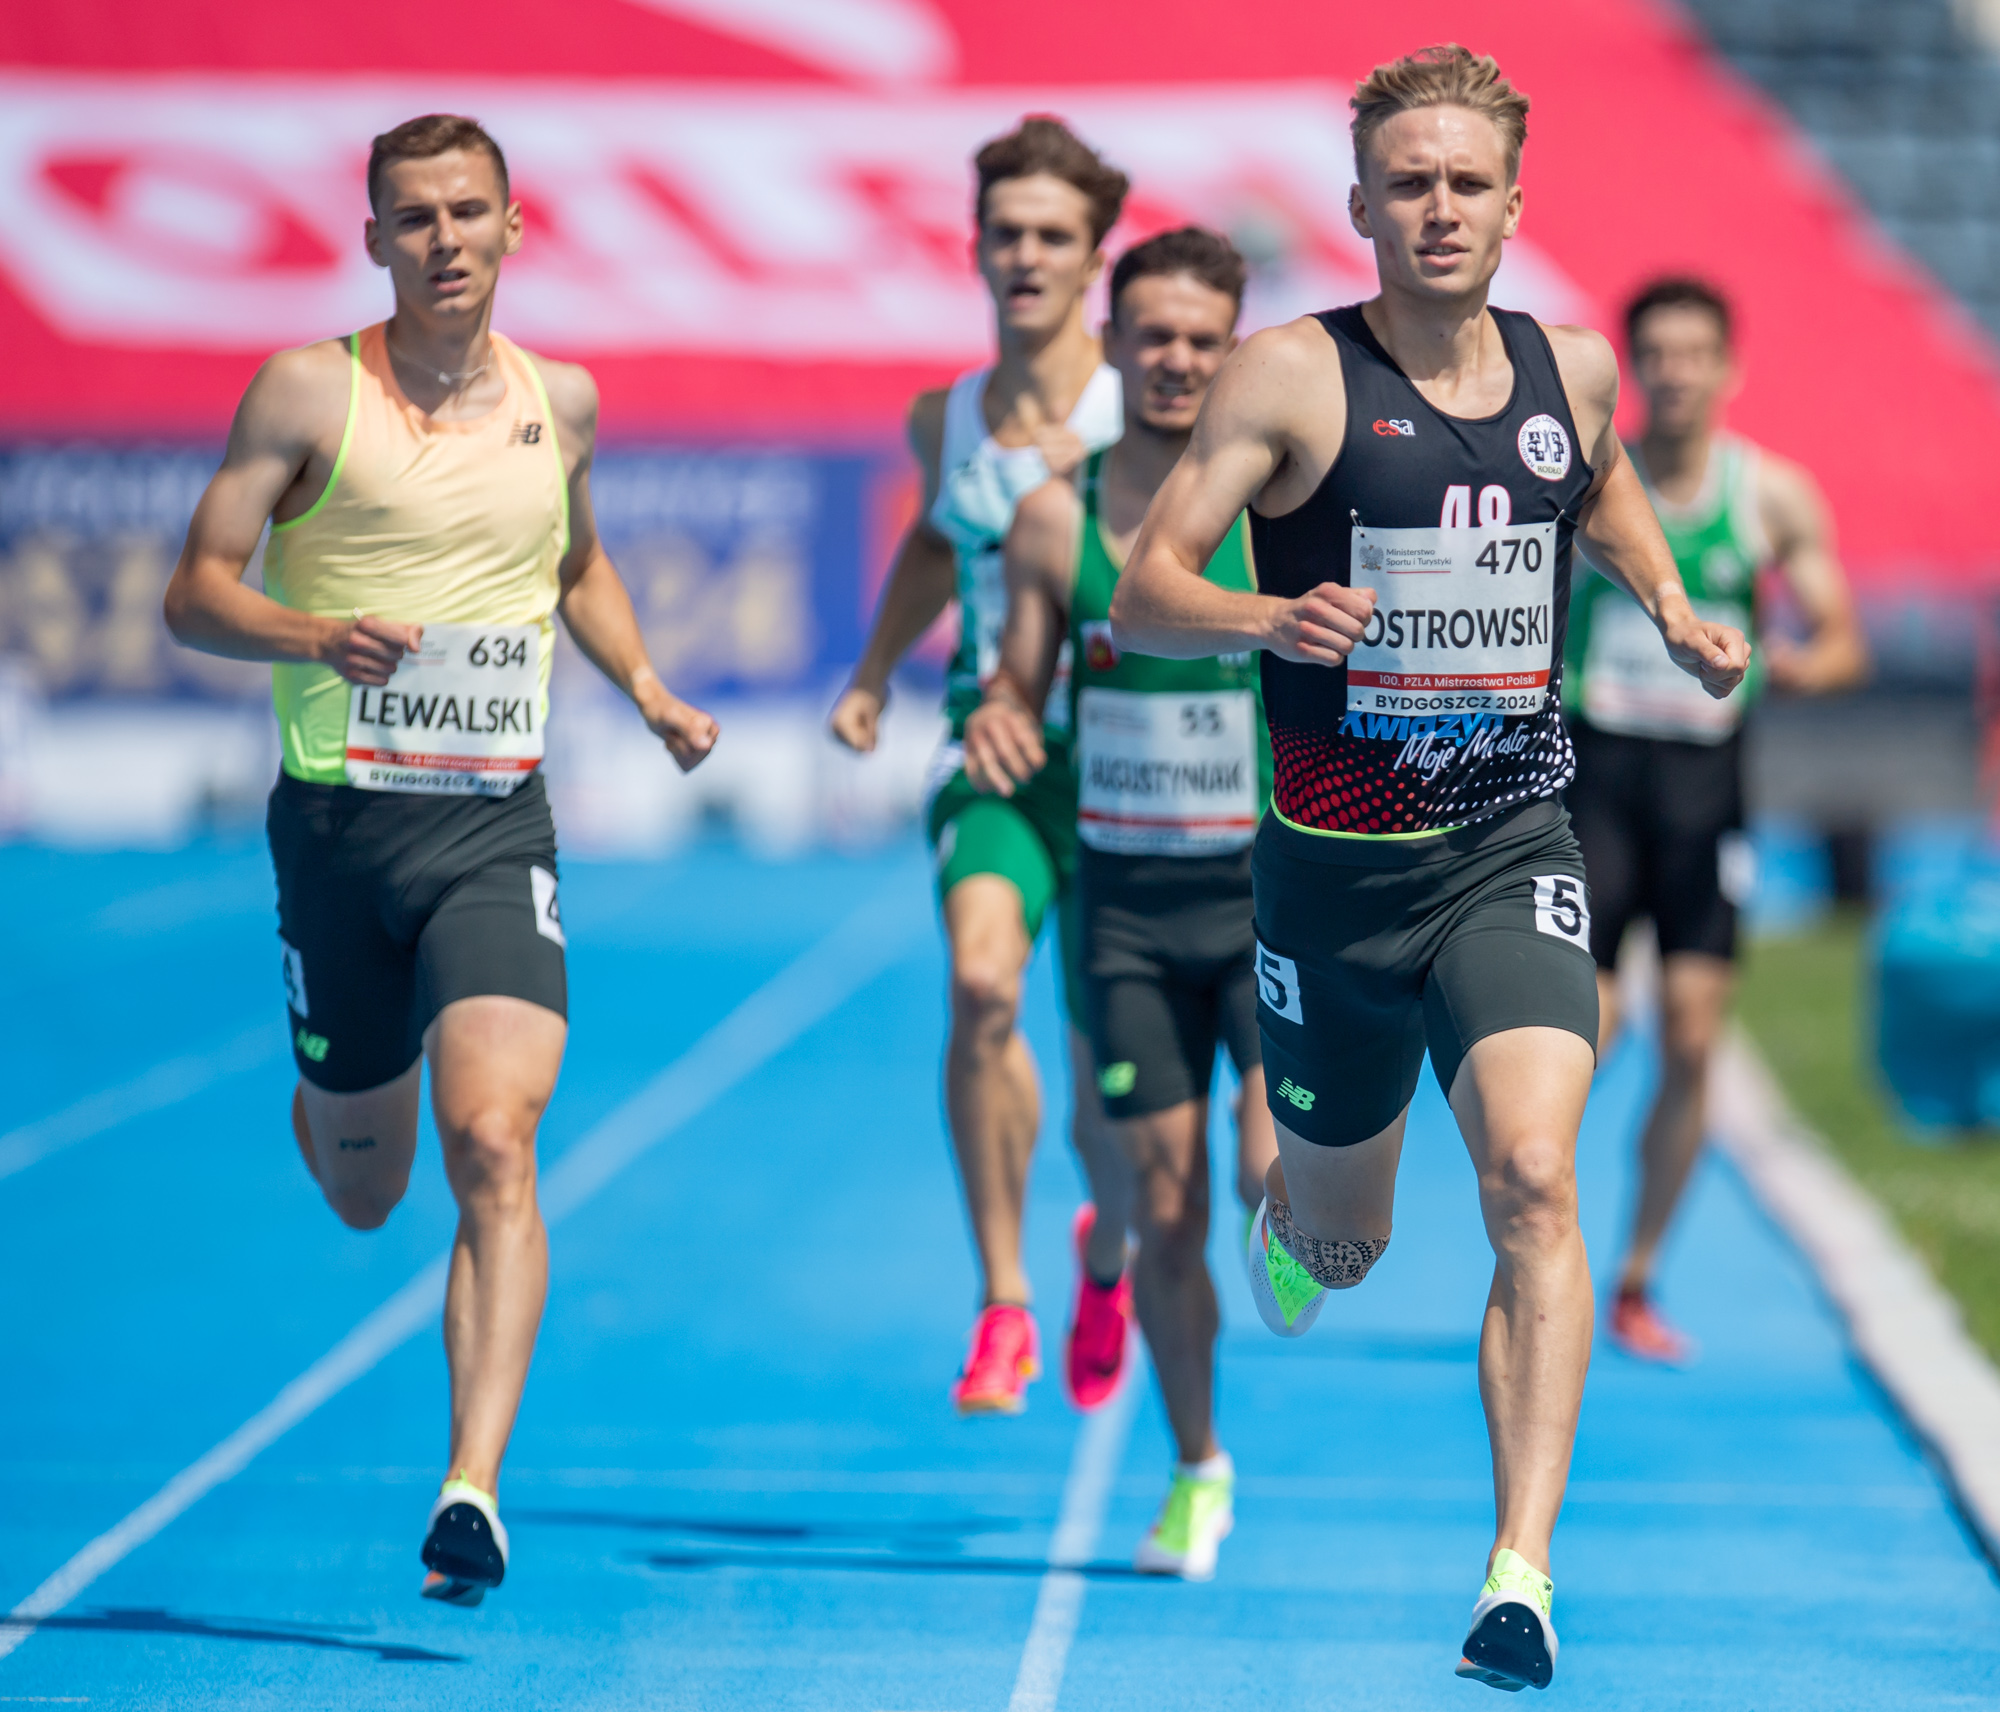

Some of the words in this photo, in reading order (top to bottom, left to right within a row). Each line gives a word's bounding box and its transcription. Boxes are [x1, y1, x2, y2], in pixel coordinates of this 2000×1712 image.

[1372, 418, 1416, 436] esa
[1386, 548, 1436, 556] Ministerstwo
[1386, 557, 1412, 566] Sportu
[1417, 557, 1452, 566] Turystyki
[1475, 537, 1543, 575] 470
[1361, 604, 1548, 649] OSTROWSKI
[468, 635, 528, 668] 634
[1379, 674, 1401, 686] 100.
[1404, 677, 1431, 687] PZLA
[1434, 676, 1504, 688] Mistrzostwa
[1506, 674, 1536, 686] Polski
[358, 687, 532, 735] LEWALSKI
[1375, 694, 1491, 710] BYDGOSZCZ
[1495, 694, 1537, 710] 2024
[1393, 731, 1457, 781] Moje
[369, 768, 475, 789] BYDGOSZCZ
[1551, 878, 1582, 937] 5
[1260, 957, 1288, 1010] 5
